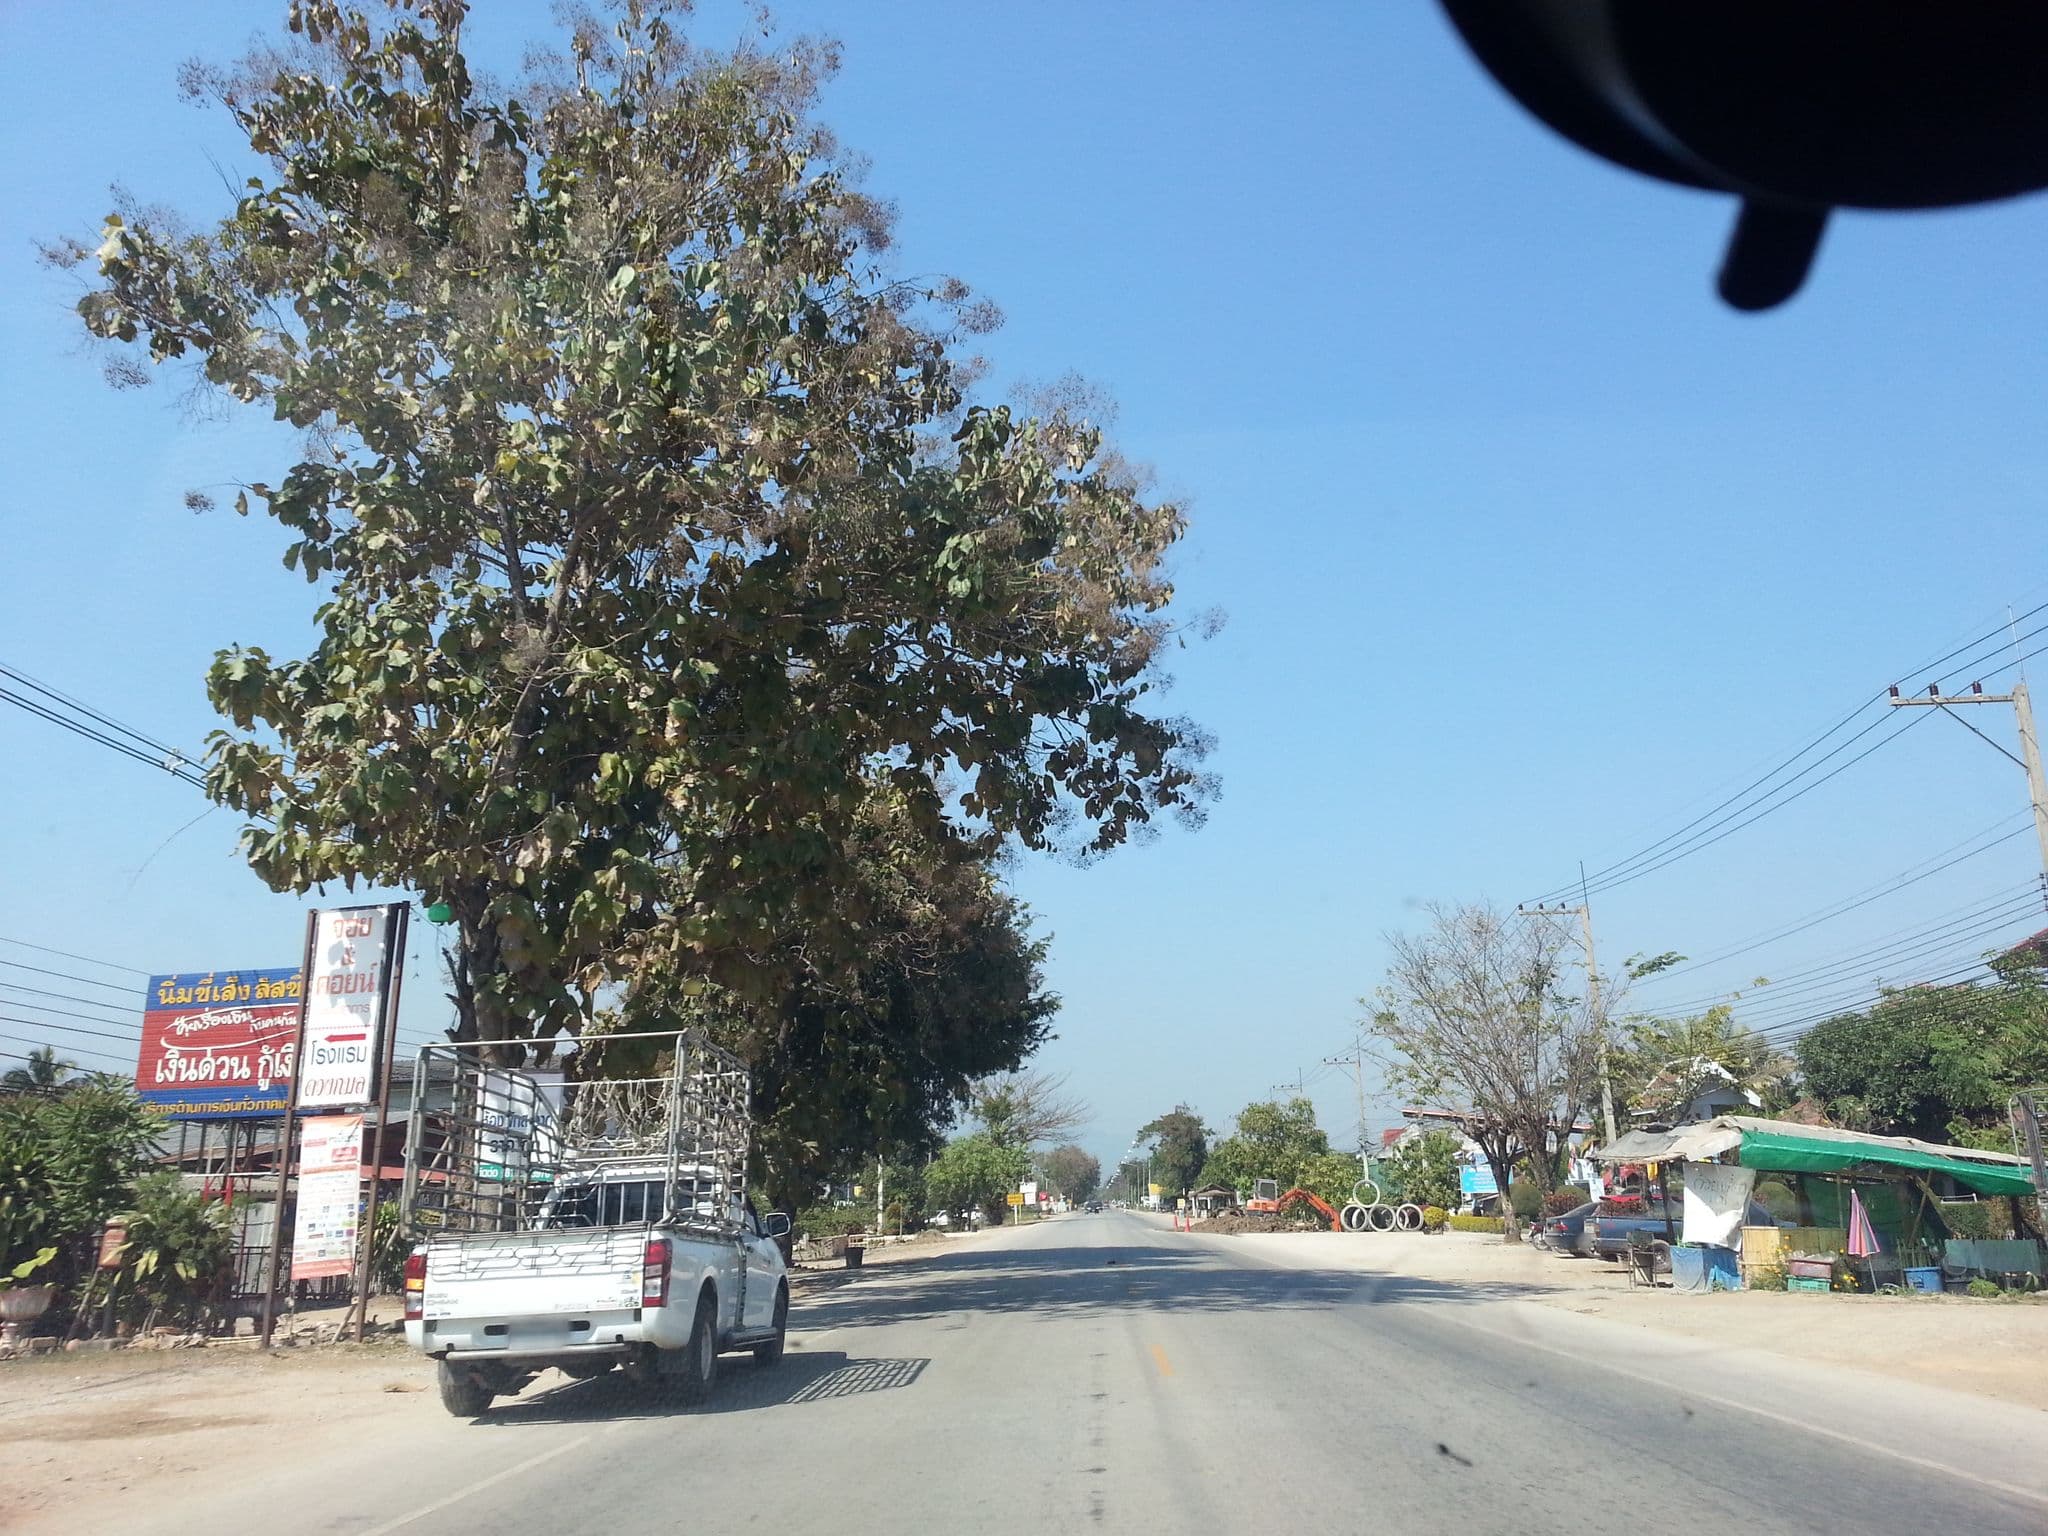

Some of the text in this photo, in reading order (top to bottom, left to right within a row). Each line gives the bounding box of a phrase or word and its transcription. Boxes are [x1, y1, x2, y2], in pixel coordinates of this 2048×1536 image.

[155, 1048, 251, 1084] เงินด่วน
[311, 1040, 367, 1066] โรงแรม
